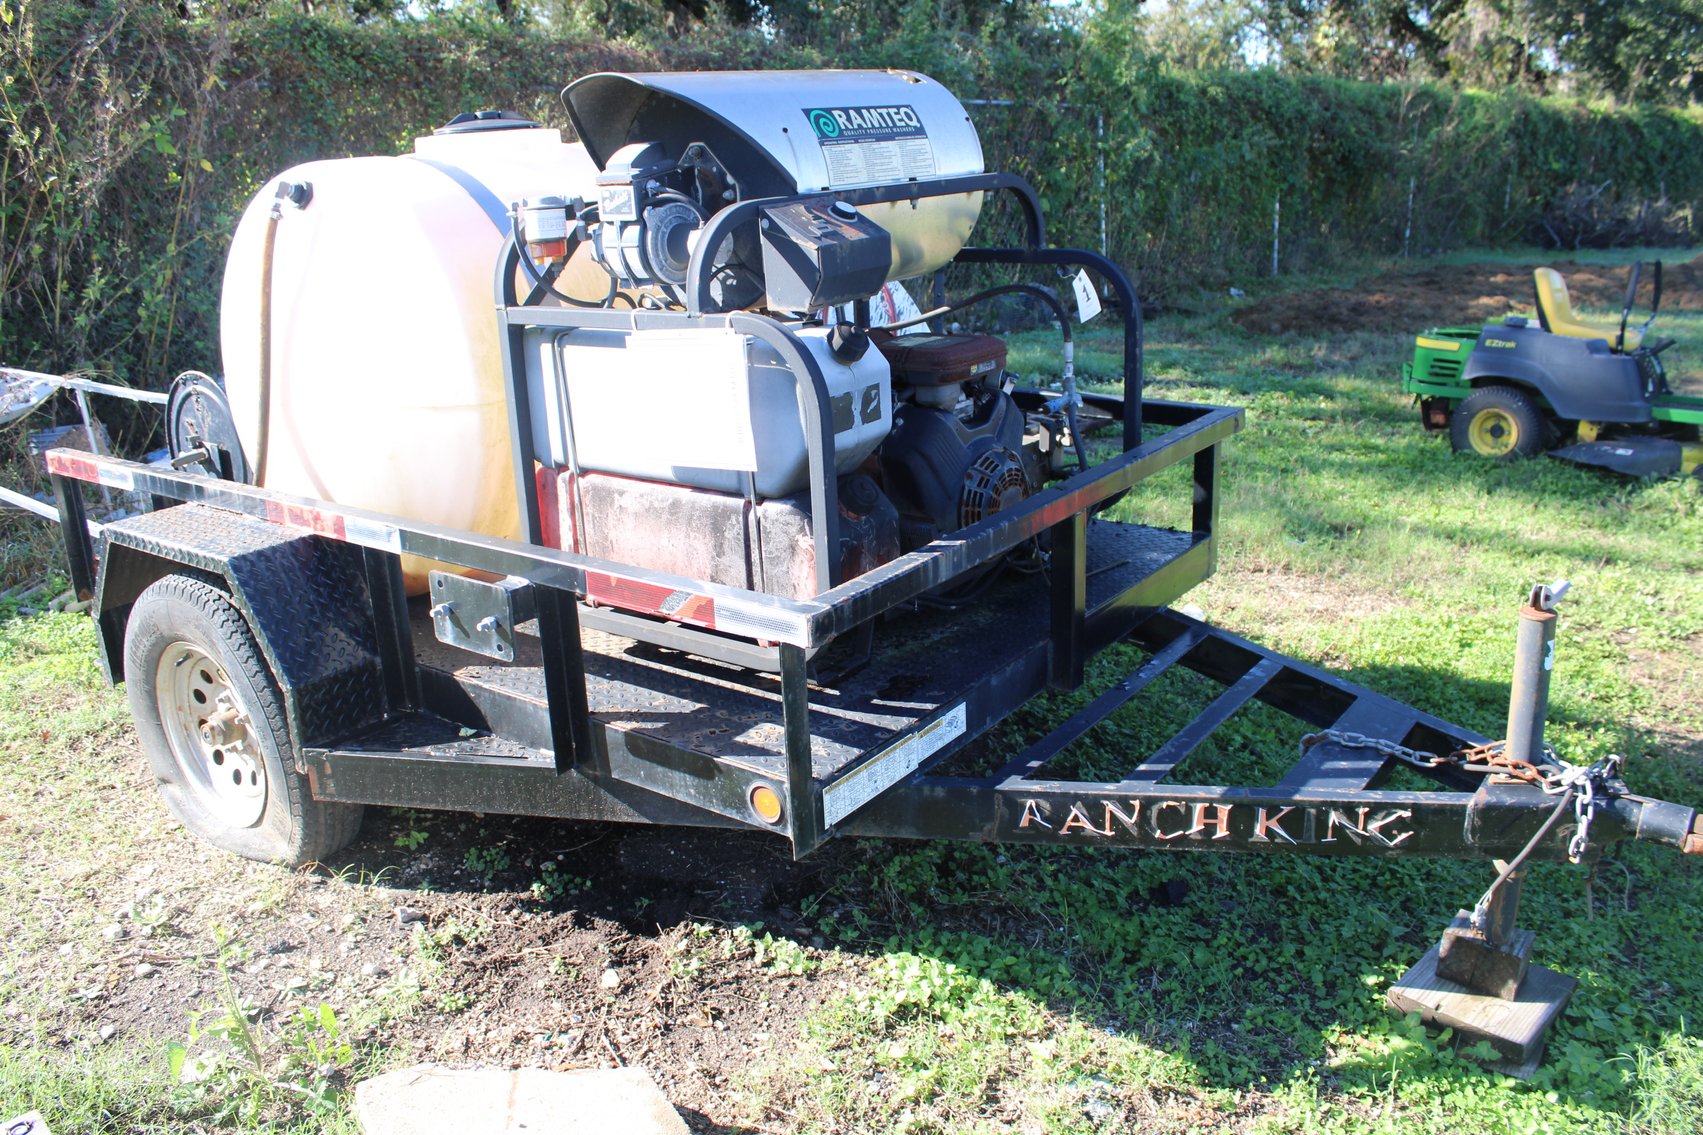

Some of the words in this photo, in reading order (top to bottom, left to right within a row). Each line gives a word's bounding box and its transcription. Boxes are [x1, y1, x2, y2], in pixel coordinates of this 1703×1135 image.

[831, 107, 921, 130] RAMTEQ
[1082, 284, 1091, 302] 1
[1012, 799, 1235, 840] RANCH
[1247, 804, 1415, 847] KING
